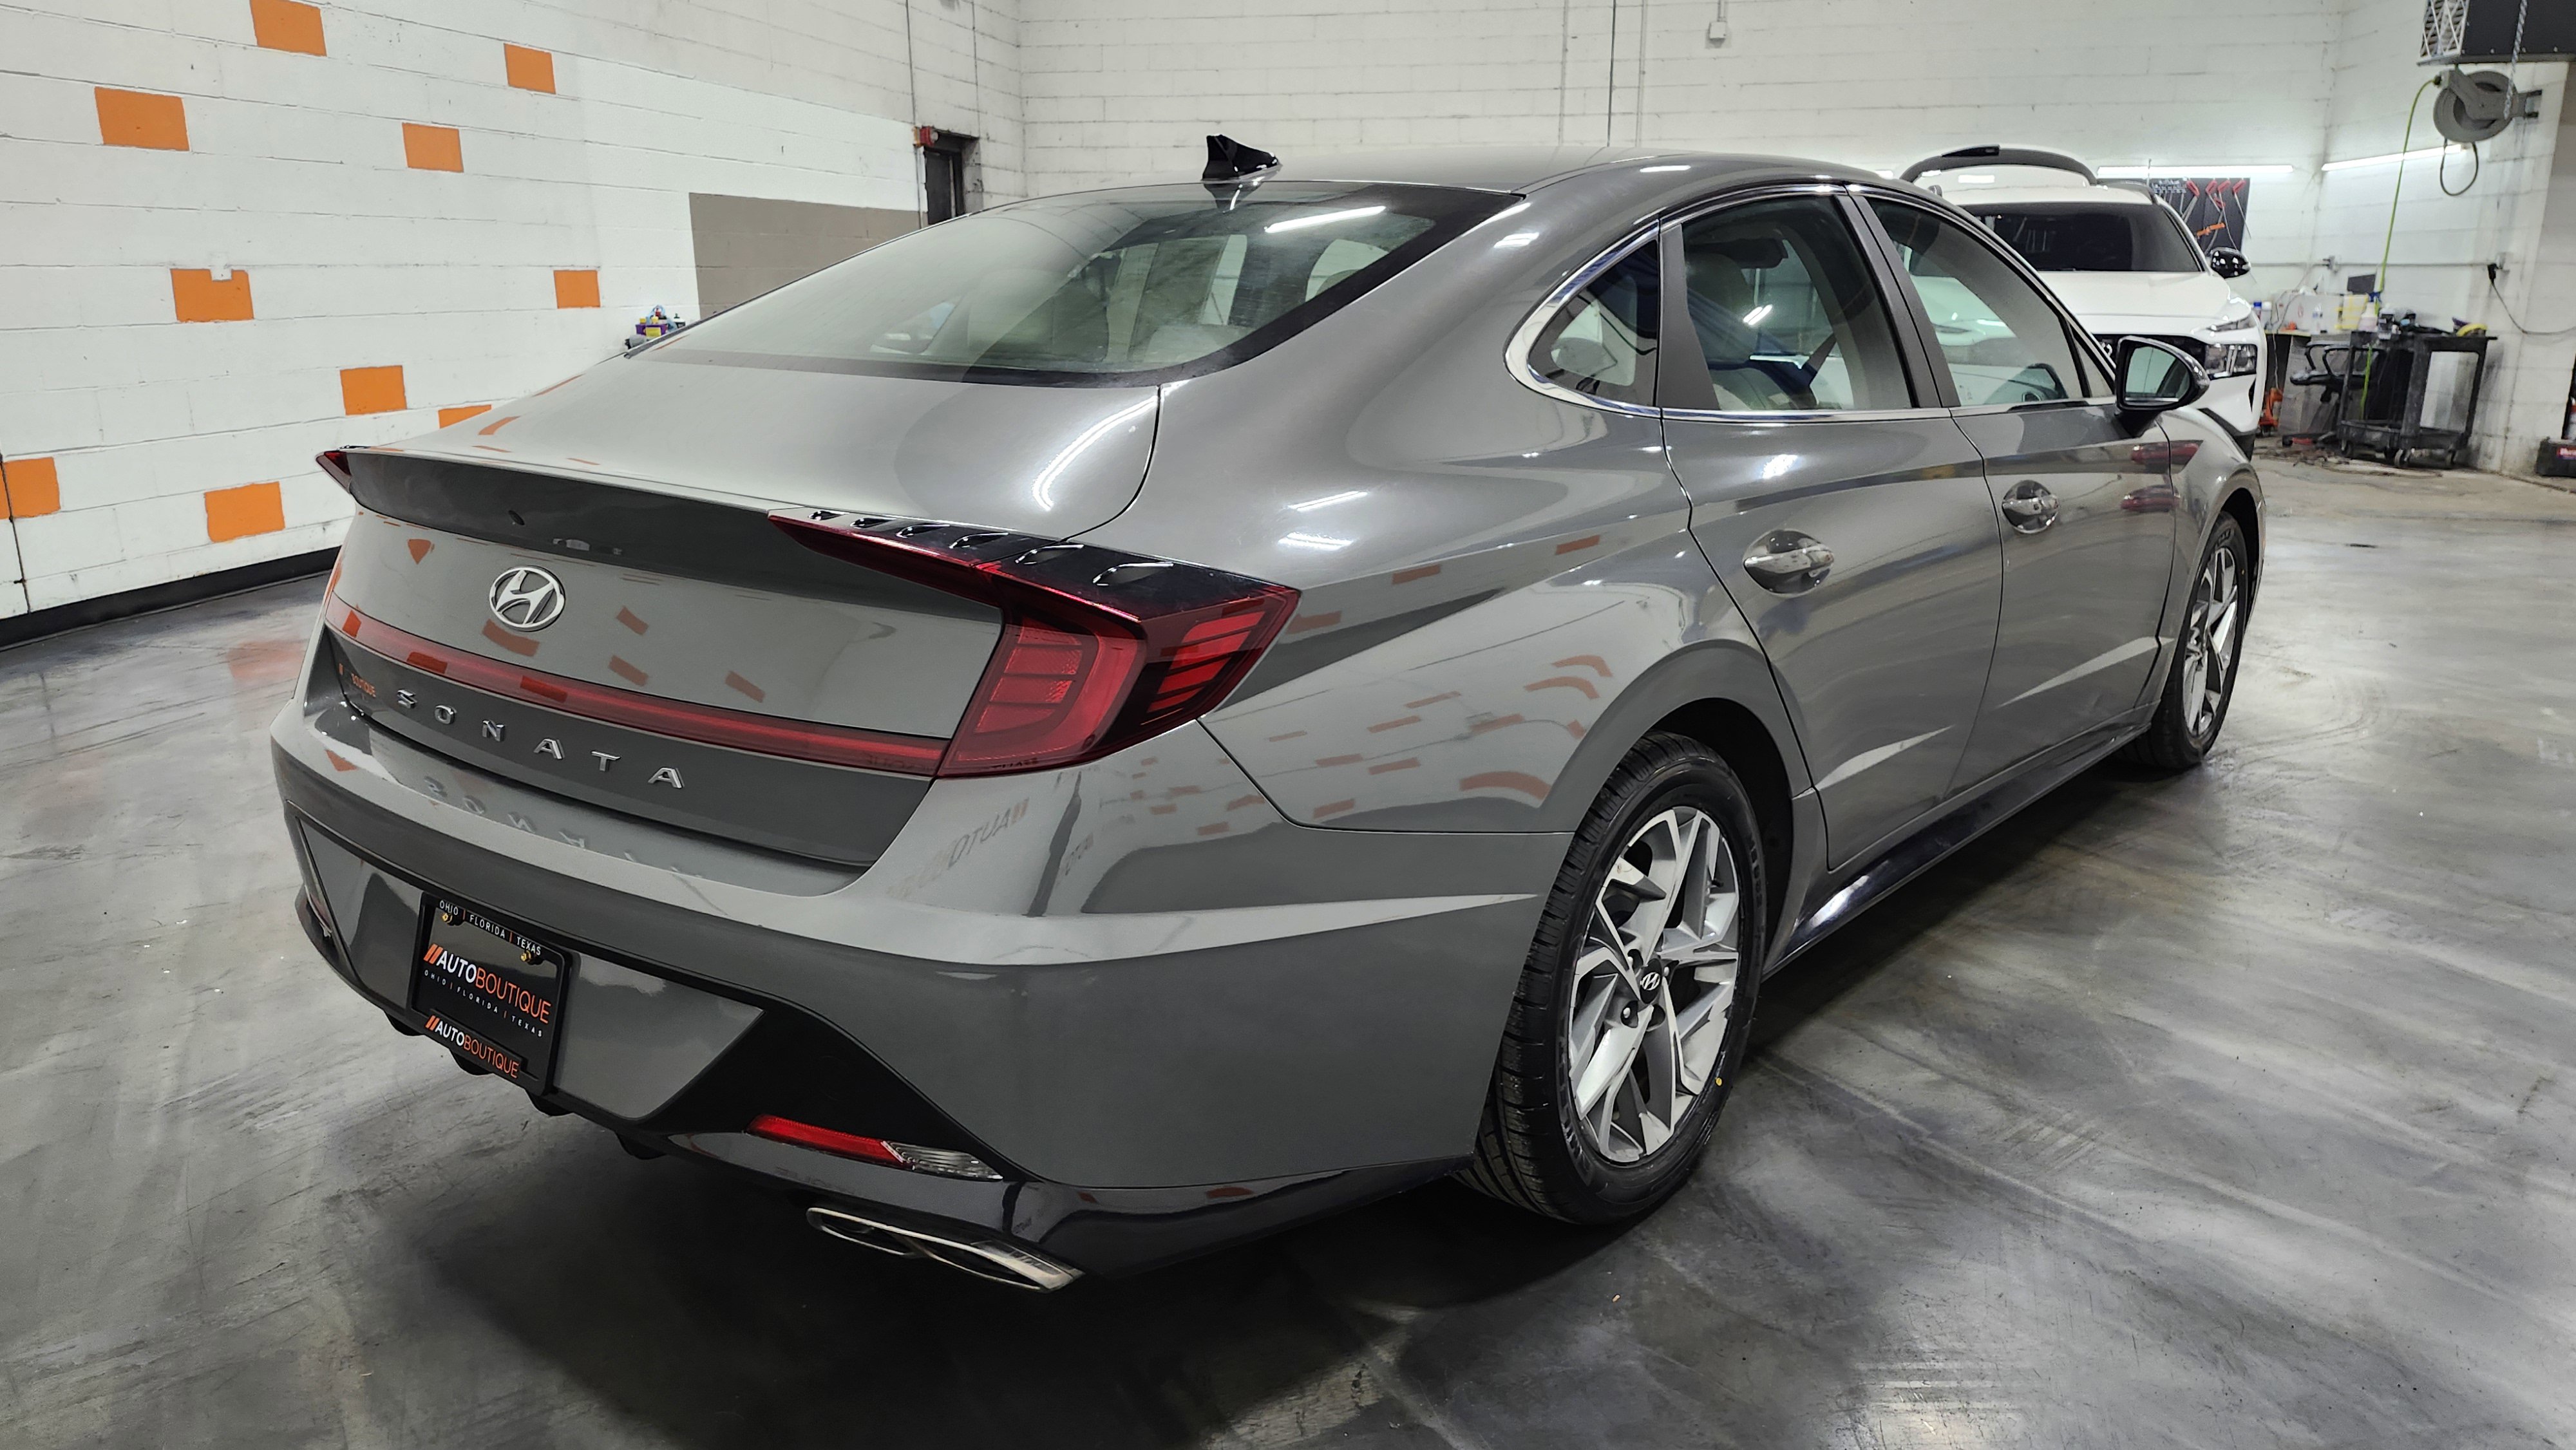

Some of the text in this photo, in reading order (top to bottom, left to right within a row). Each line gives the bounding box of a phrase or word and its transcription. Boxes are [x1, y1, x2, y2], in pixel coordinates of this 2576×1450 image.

[396, 688, 685, 789] SONATA
[439, 899, 542, 956] OHIO FLORIDA TEXAS
[424, 969, 544, 1038] OHIO FLORIDA TEXAS
[435, 950, 552, 1024] AUTOBOUTIQUE
[434, 1020, 519, 1079] AUTOBOUTIQUE
